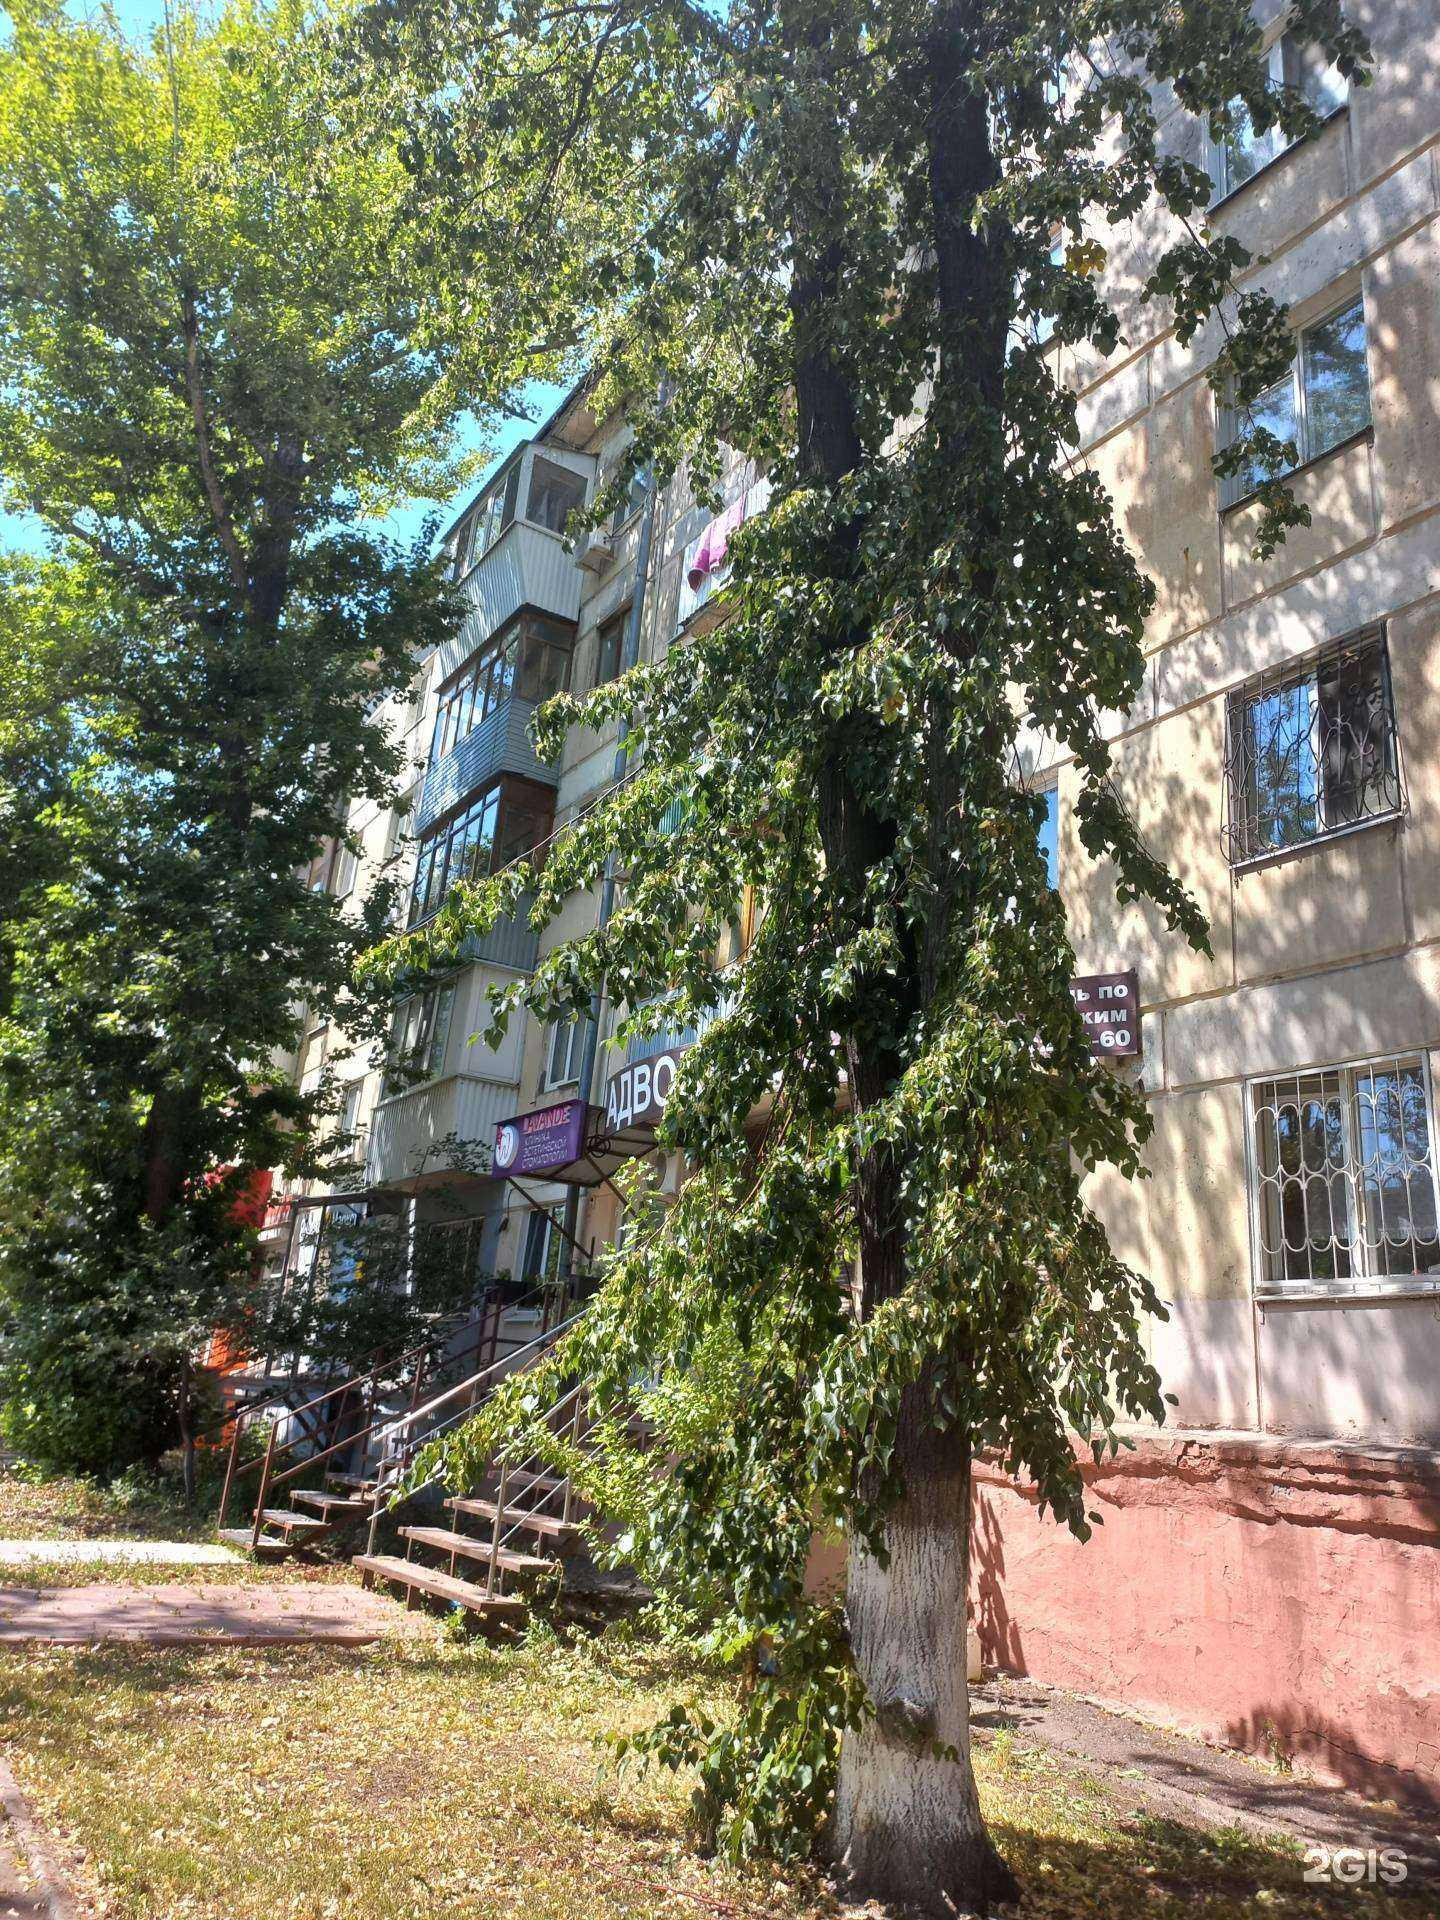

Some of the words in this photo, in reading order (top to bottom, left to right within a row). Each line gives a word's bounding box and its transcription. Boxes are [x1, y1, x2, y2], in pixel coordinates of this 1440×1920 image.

[1092, 1029, 1131, 1048] -60
[606, 1055, 679, 1131] АДВО
[521, 1105, 572, 1135] LAVANDE
